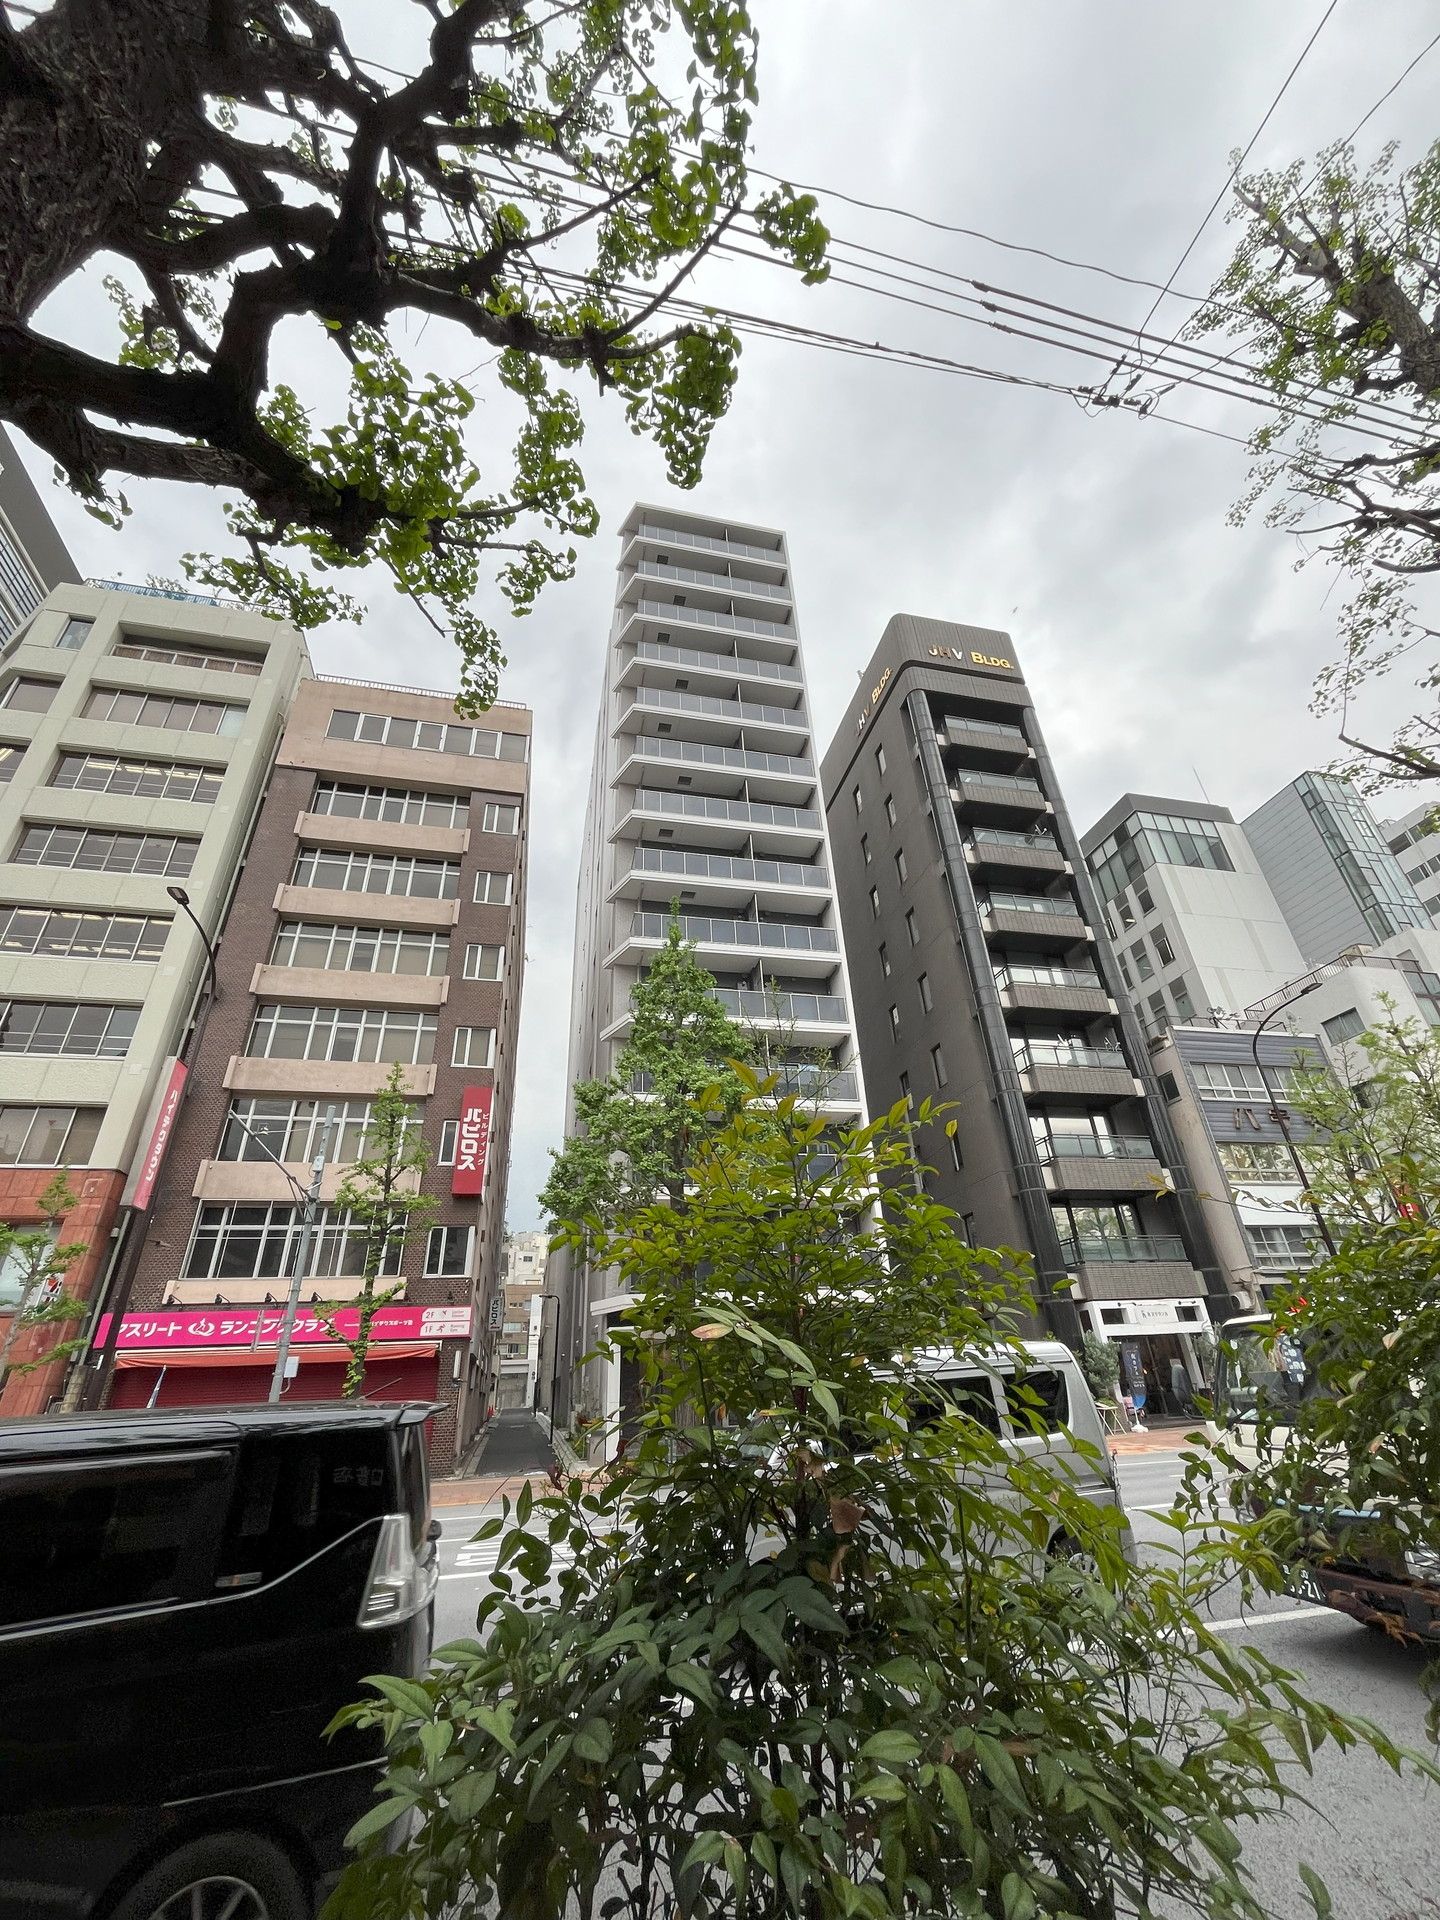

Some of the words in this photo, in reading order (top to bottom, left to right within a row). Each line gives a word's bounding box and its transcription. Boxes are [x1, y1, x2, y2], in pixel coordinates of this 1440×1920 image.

[928, 644, 963, 660] JHV
[970, 651, 1014, 670] BLDG.
[856, 702, 871, 737] JHV
[457, 1108, 482, 1170] パピロス
[477, 1113, 490, 1166] ビルディング
[424, 1325, 433, 1333] 1F
[425, 1311, 435, 1319] 2F
